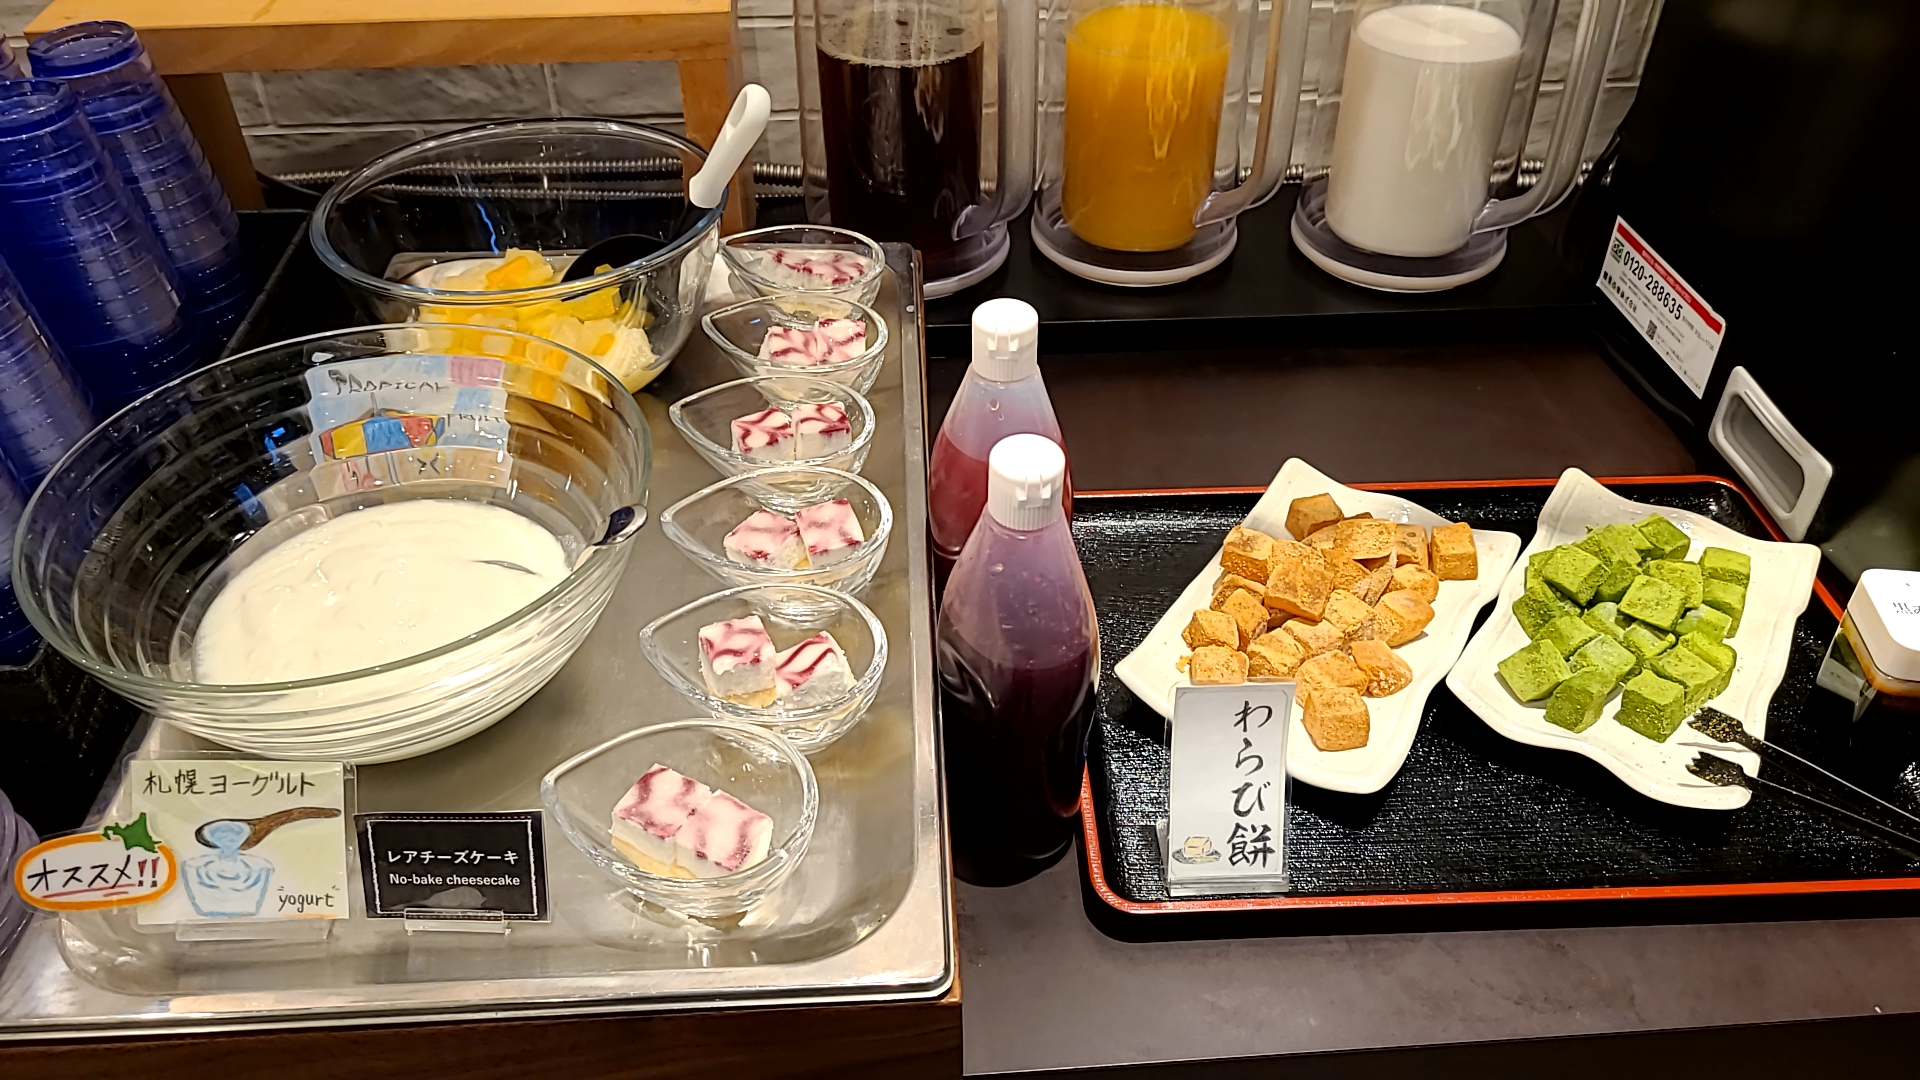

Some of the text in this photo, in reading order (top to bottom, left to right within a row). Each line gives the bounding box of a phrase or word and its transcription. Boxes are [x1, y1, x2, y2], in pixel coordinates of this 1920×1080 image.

[1623, 250, 1684, 320] 0120-288635
[142, 768, 316, 797] 札幌ヨーグルト
[1226, 700, 1276, 868] わらび餅
[386, 850, 520, 866] レアチーズケーキ
[389, 873, 521, 887] No-bake cheesecake
[278, 892, 336, 913] yogurt
